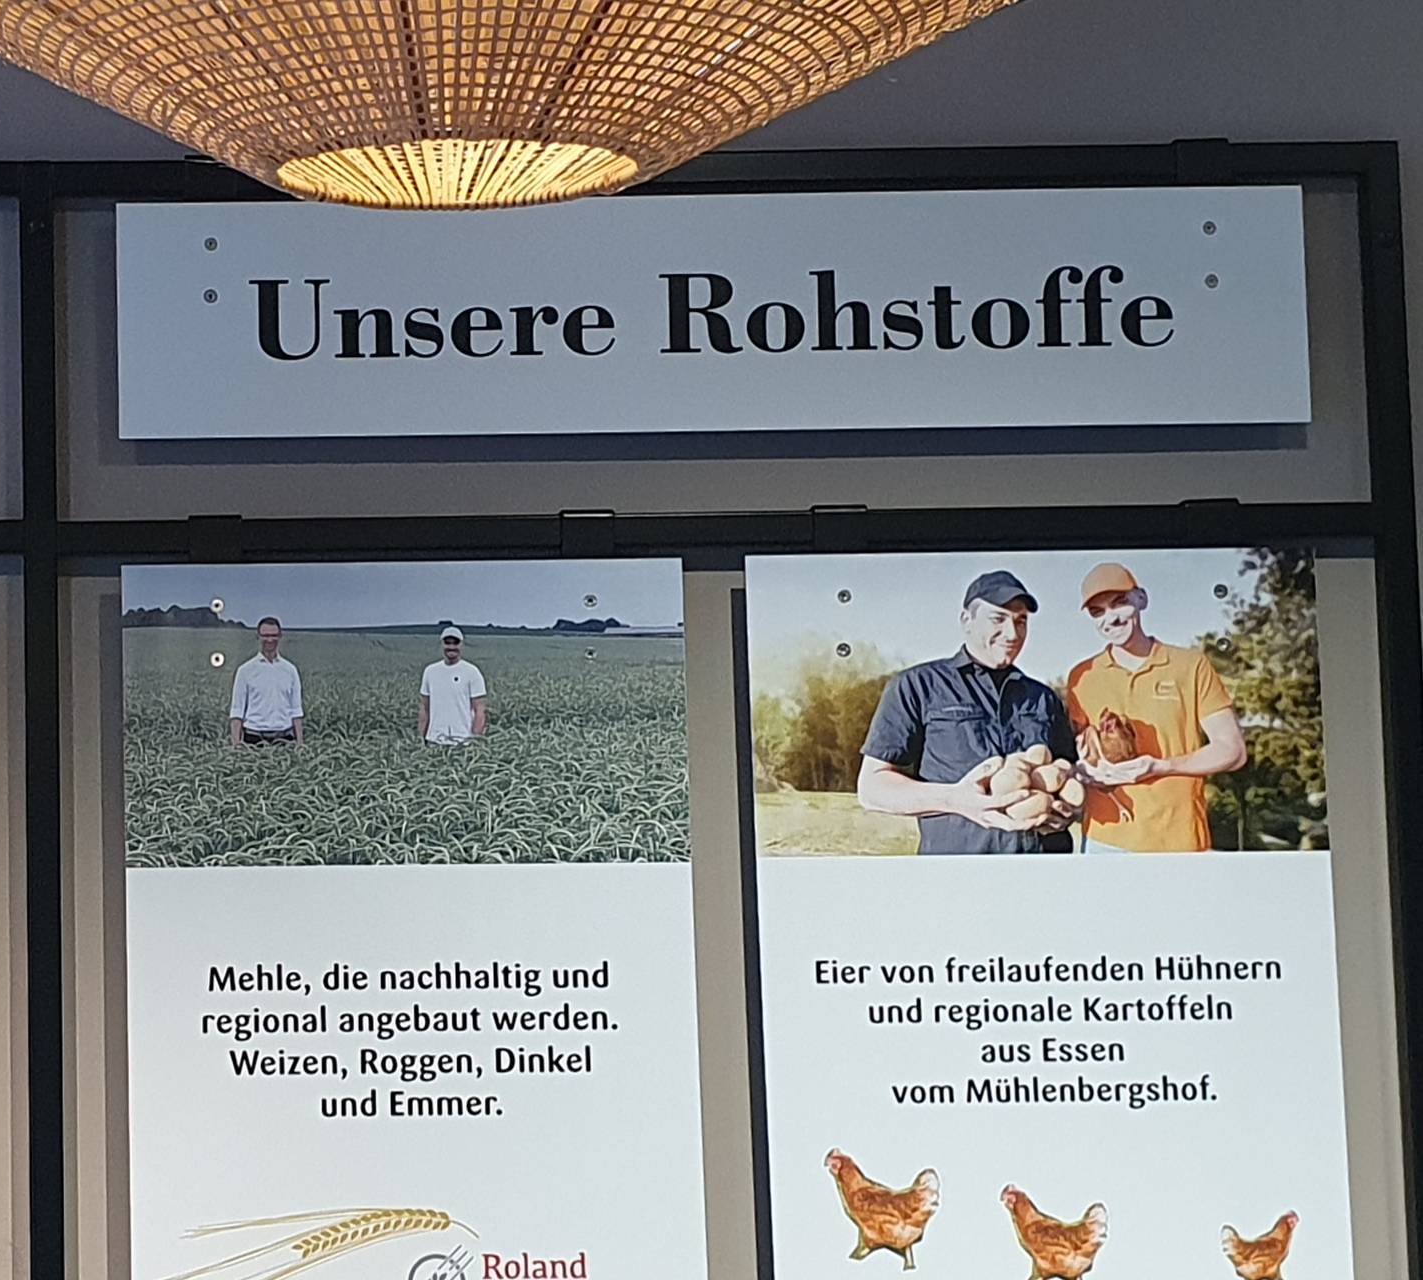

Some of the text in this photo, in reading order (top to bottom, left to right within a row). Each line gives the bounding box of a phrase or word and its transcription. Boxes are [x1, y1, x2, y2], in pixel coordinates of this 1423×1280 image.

[248, 264, 1177, 361] Unsere Rohstoffe
[208, 960, 609, 997] Mehle, die nachhaltig und
[815, 954, 1282, 984] Eier von freilaufenden Hühnern
[202, 1002, 618, 1042] regional angebaut werden.
[868, 994, 1233, 1031] und regionale Kartoffeln
[229, 1045, 592, 1083] Weizen, Roggen, Dinkel
[981, 1038, 1125, 1063] aus Essen
[321, 1088, 503, 1118] und Emmer.
[891, 1074, 1217, 1110] vom Mühlenbergshof.
[482, 1252, 587, 1280] Roland
